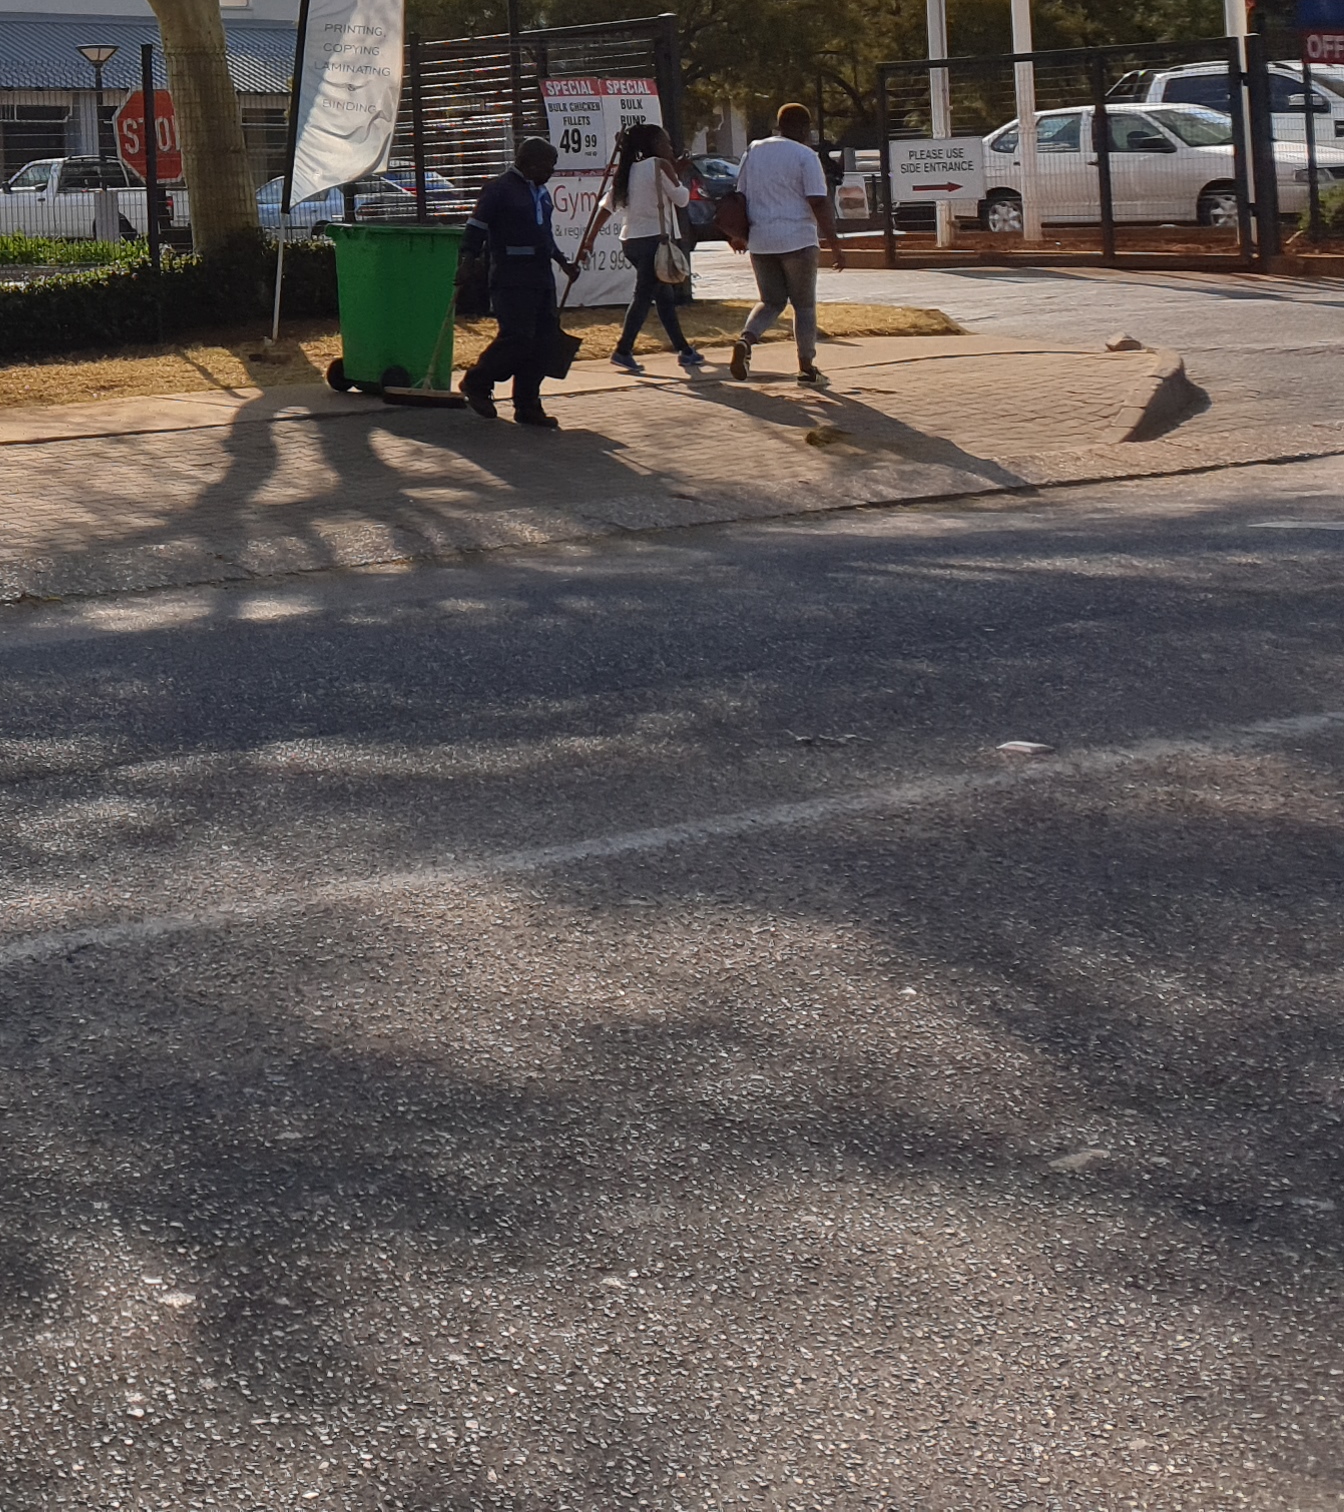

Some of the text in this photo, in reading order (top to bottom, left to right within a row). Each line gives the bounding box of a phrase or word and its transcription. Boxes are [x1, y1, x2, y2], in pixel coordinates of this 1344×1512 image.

[324, 23, 386, 38] PRINTING,
[323, 42, 380, 56] COPYING
[314, 61, 391, 76] LAMINATING
[546, 80, 594, 96] SPECIAL
[606, 79, 651, 94] SPECIAL
[620, 98, 643, 109] BULK
[563, 115, 591, 126] FILLETS
[123, 114, 181, 154] SO
[560, 128, 597, 154] 49 99
[908, 147, 964, 160] PLEASE USE
[900, 160, 974, 174] SIDE ENTRANCE
